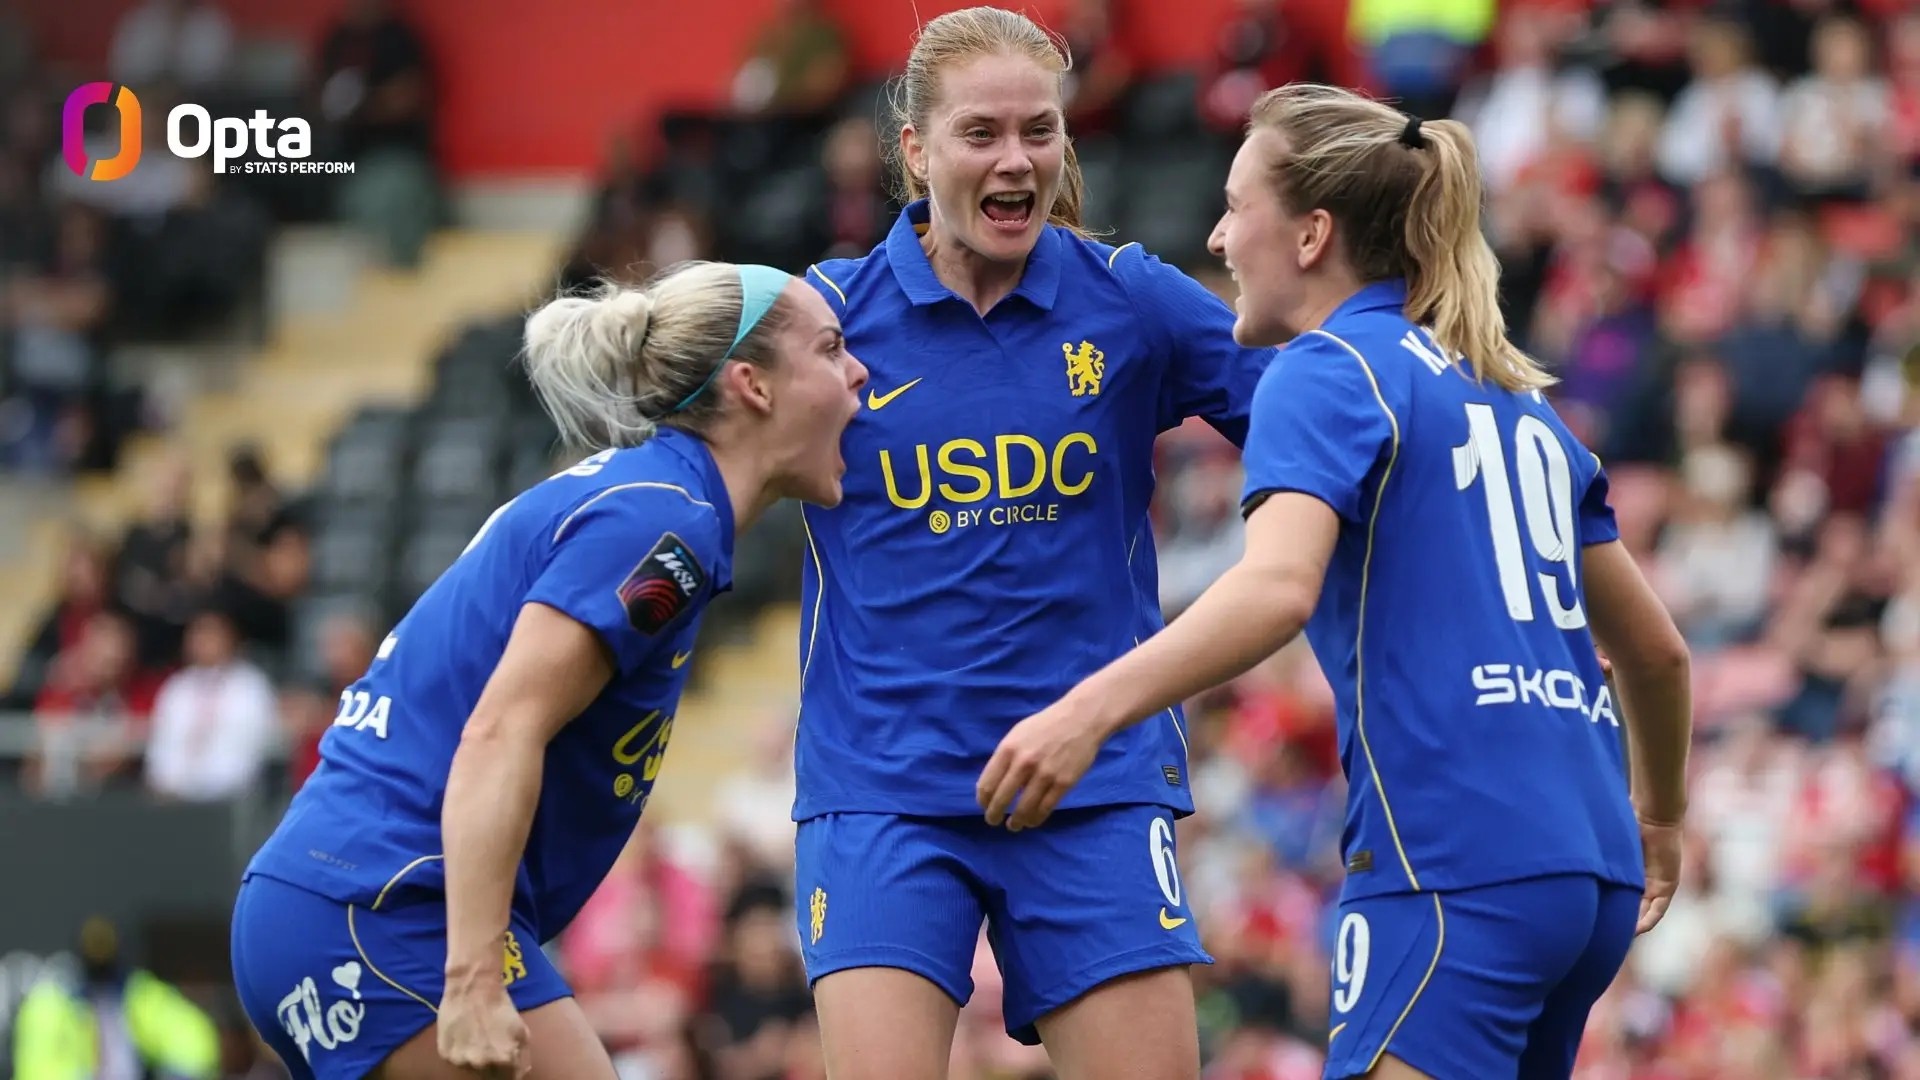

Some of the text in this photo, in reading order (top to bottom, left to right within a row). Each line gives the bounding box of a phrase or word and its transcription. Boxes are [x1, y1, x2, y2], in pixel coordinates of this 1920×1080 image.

[879, 431, 1098, 510] USDC
[957, 503, 1059, 528] BY CIRCLE
[1451, 402, 1587, 630] 19
[1149, 817, 1181, 907] 6
[277, 976, 366, 1065] Flo
